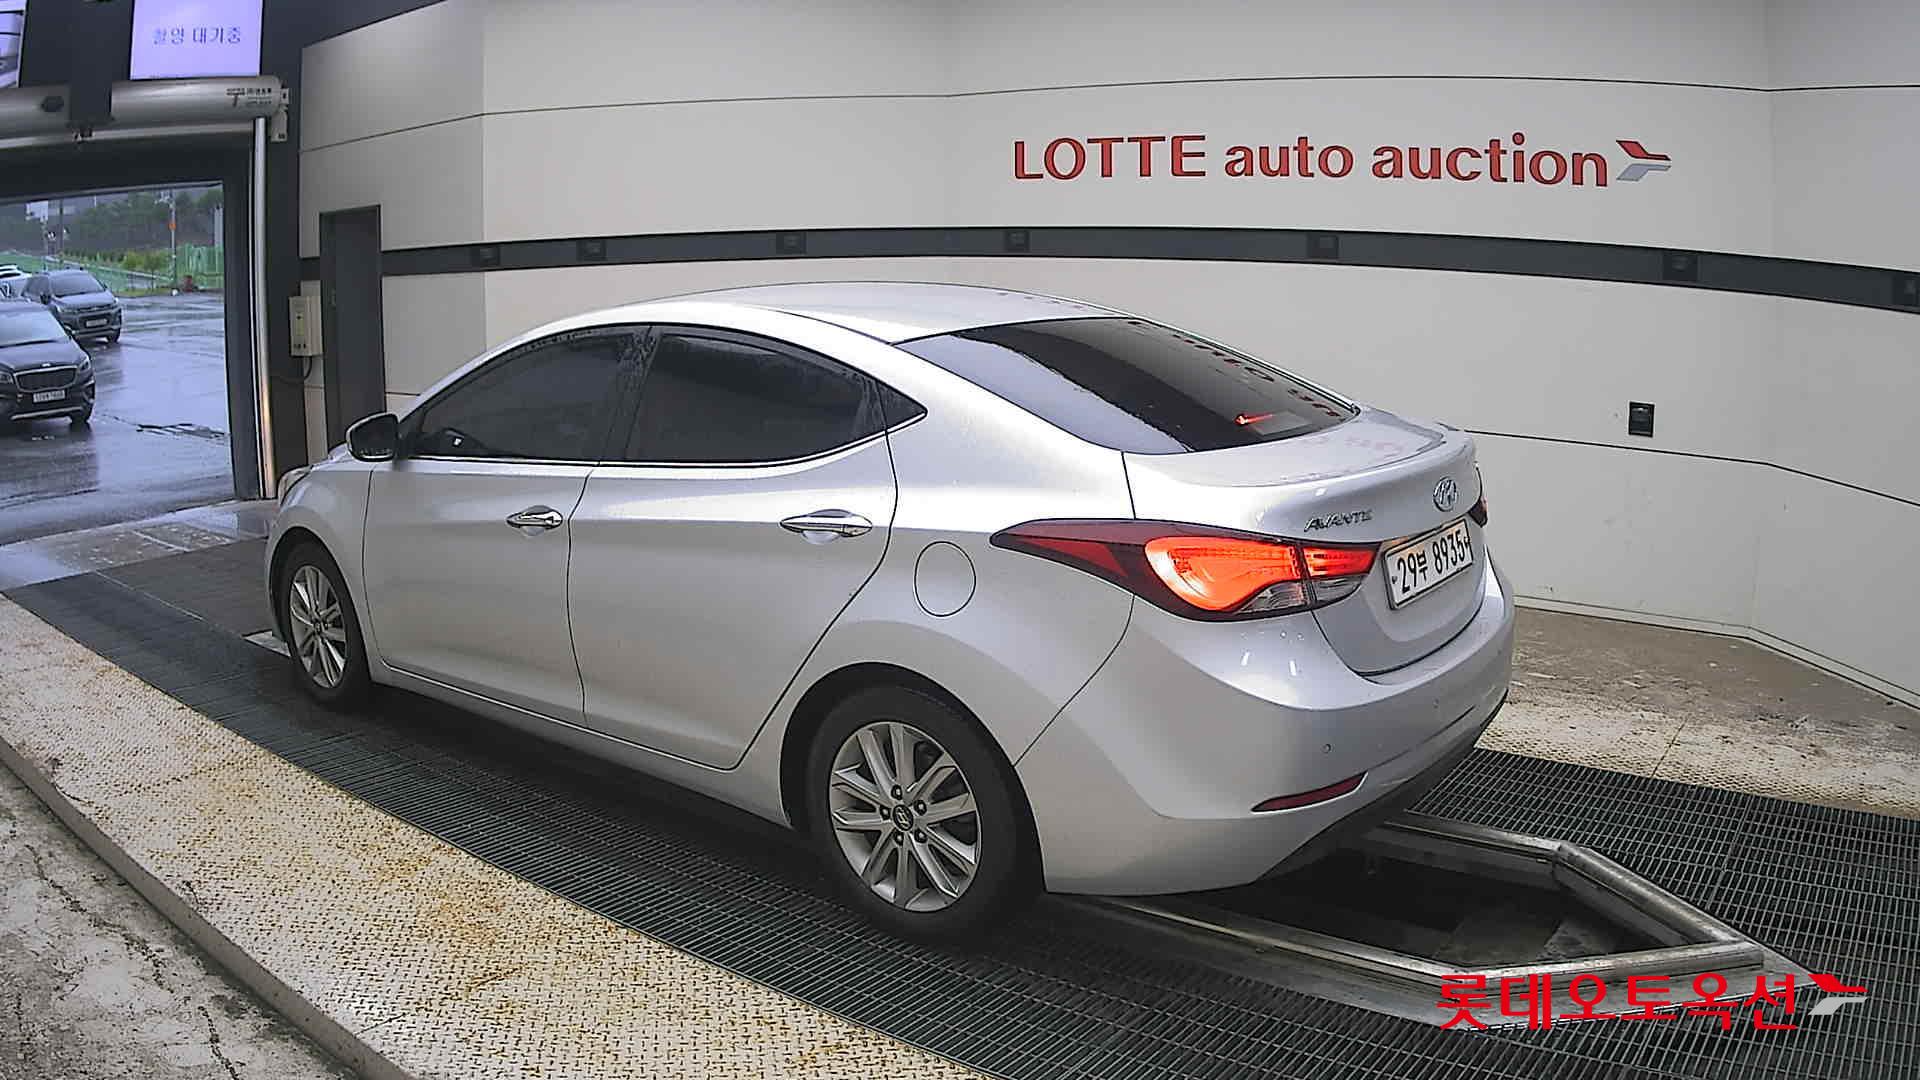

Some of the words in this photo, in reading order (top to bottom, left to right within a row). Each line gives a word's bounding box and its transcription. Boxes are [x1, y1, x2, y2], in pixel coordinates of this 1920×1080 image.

[193, 26, 241, 45] 대기중
[1014, 134, 1207, 180] LOTTE
[1225, 136, 1354, 179] auto
[1372, 132, 1608, 188] auction
[1397, 550, 1428, 593] 29부
[1432, 529, 1465, 574] 8935
